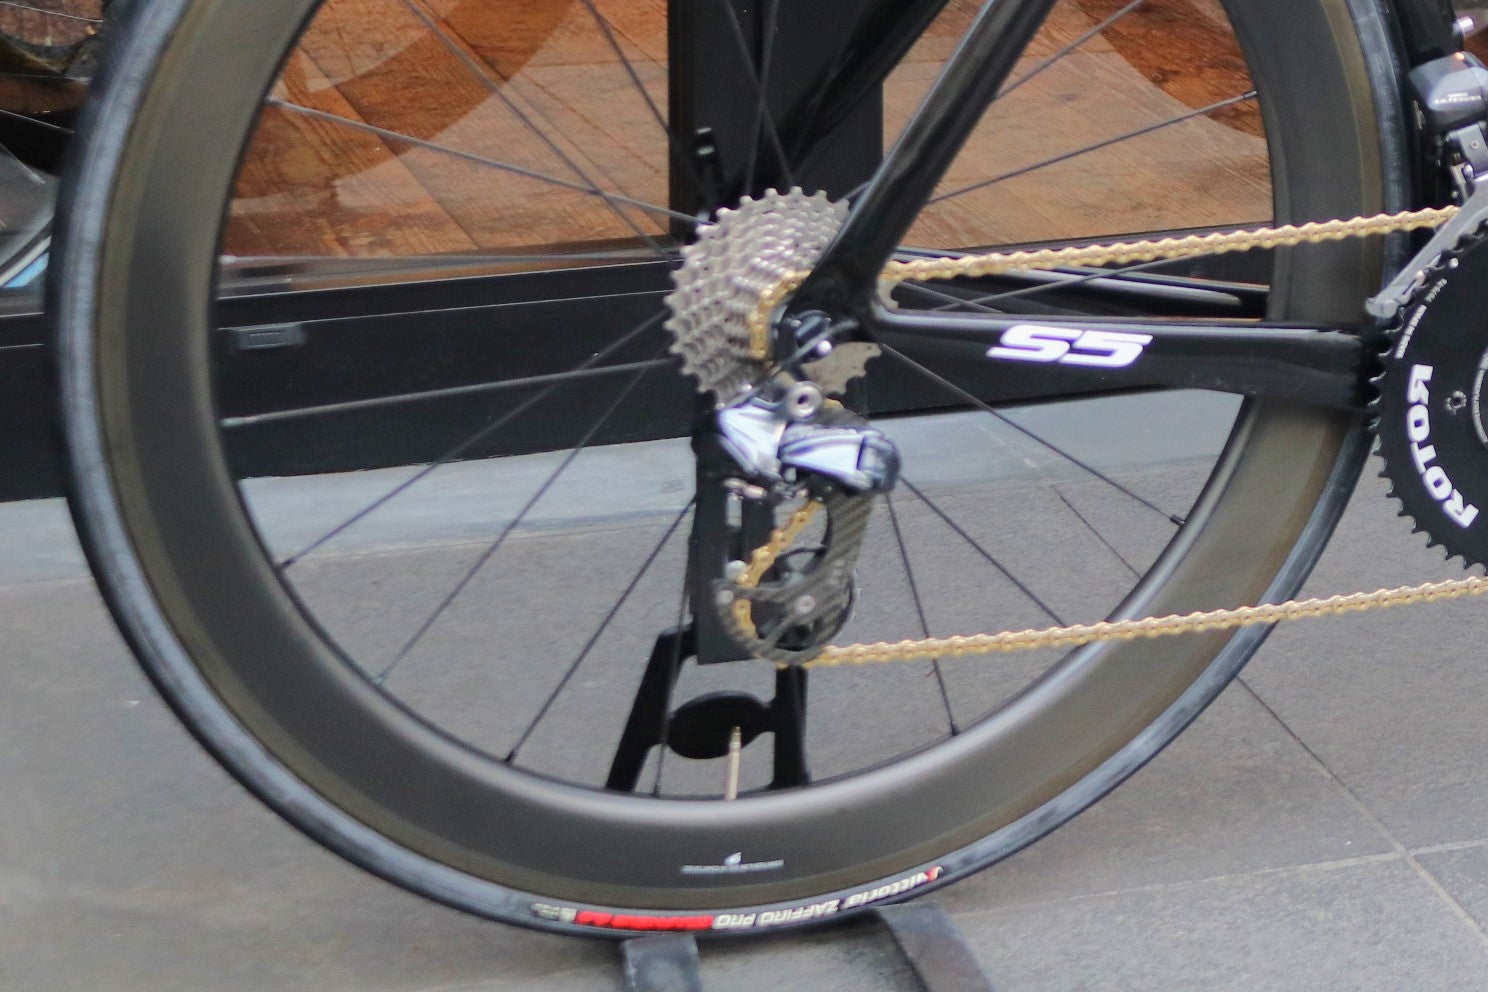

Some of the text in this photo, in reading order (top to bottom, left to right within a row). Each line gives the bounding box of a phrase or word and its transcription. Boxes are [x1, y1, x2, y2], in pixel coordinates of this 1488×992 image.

[987, 325, 1153, 367] S5
[1407, 364, 1479, 528] ROTOR
[843, 872, 928, 909] vittoria
[712, 911, 757, 930] PRO
[759, 899, 840, 926] ZAFFIRO
